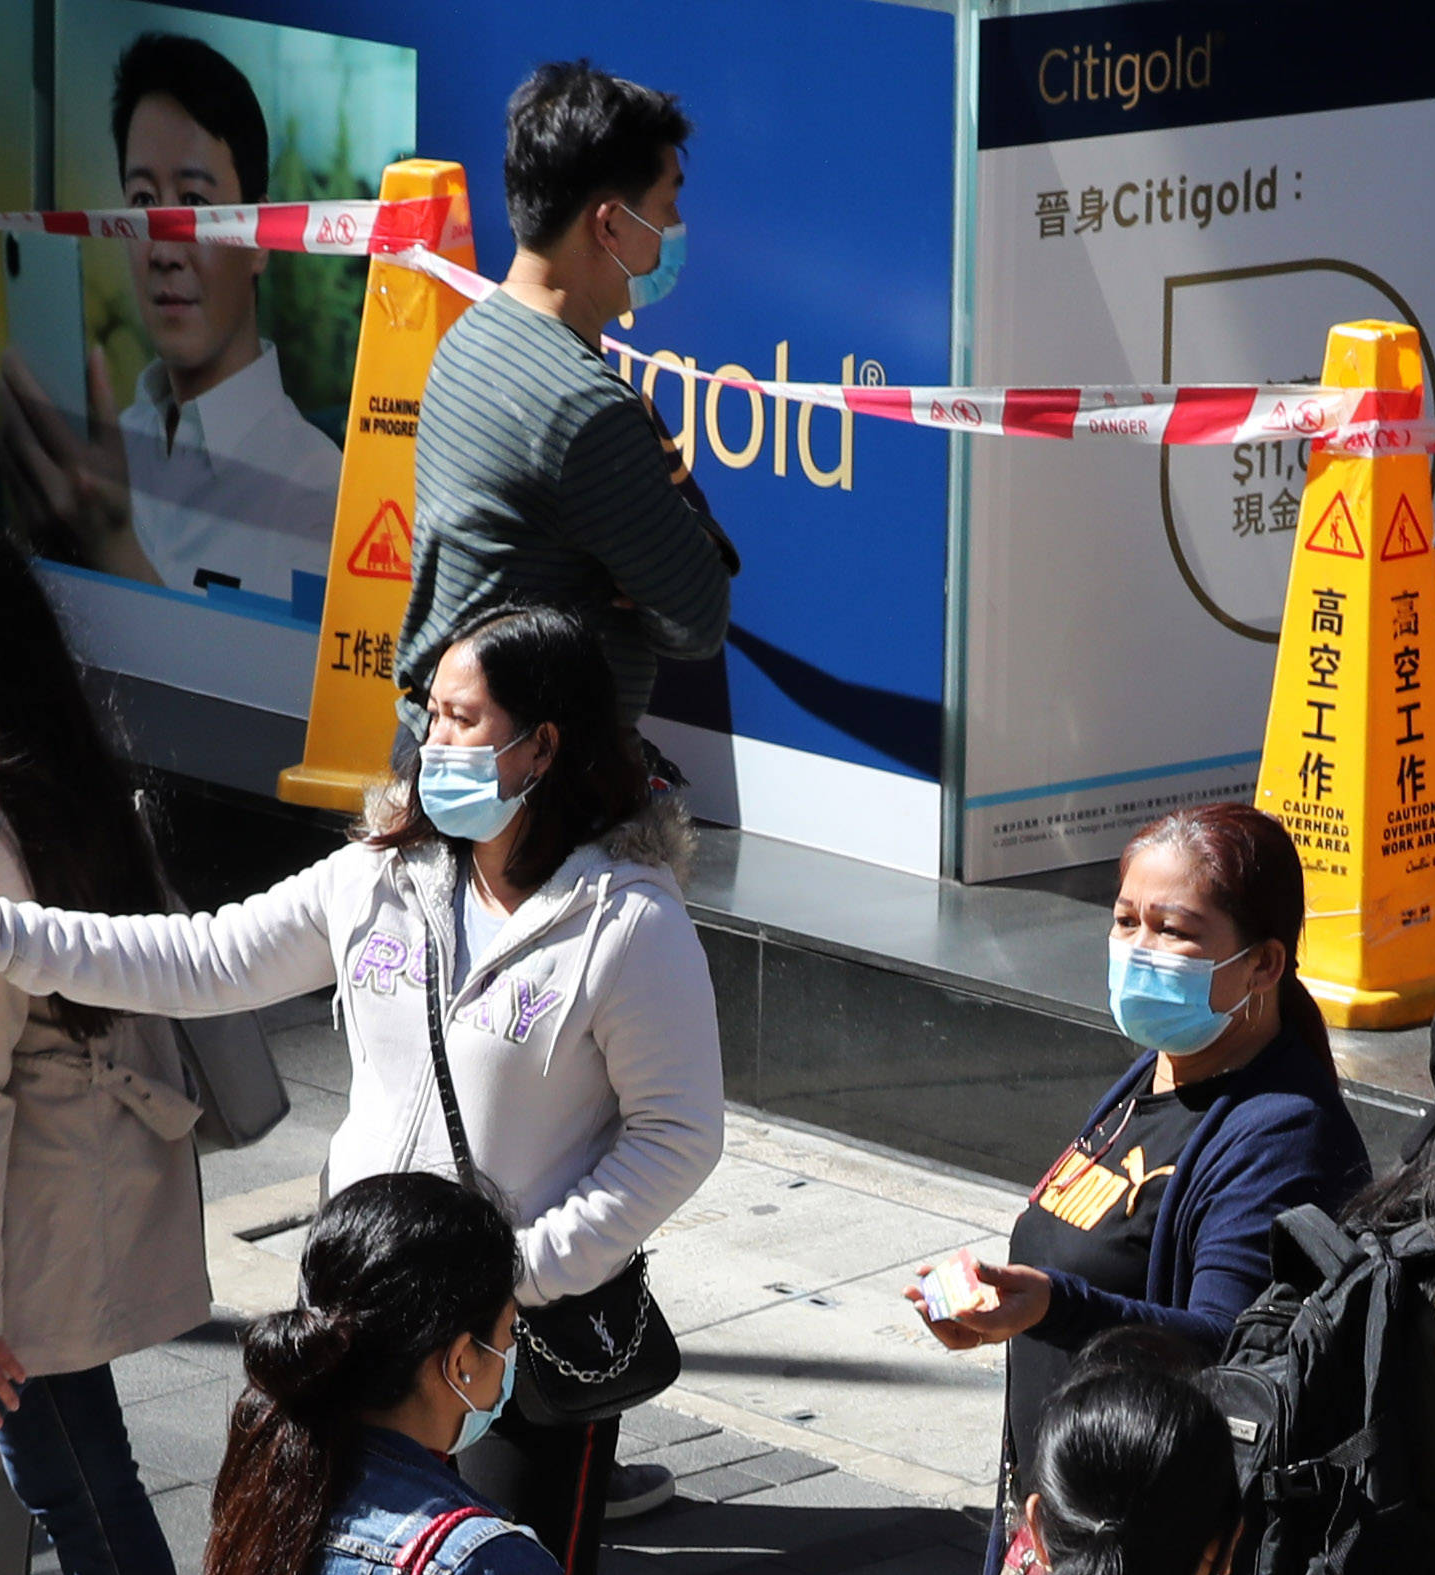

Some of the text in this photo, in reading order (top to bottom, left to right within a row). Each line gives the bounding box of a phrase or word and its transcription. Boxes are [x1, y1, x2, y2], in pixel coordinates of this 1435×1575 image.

[1038, 33, 1212, 111] Citigold
[368, 396, 420, 416] CLEANING
[359, 417, 370, 433] IN
[1089, 420, 1148, 434] DANGER
[1232, 487, 1299, 538] 現金
[1298, 588, 1347, 801] 高空工作
[1391, 590, 1427, 804] 高空工作
[1283, 800, 1344, 821] CAUTION
[1315, 837, 1351, 854] AREA
[1381, 839, 1414, 857] WORK
